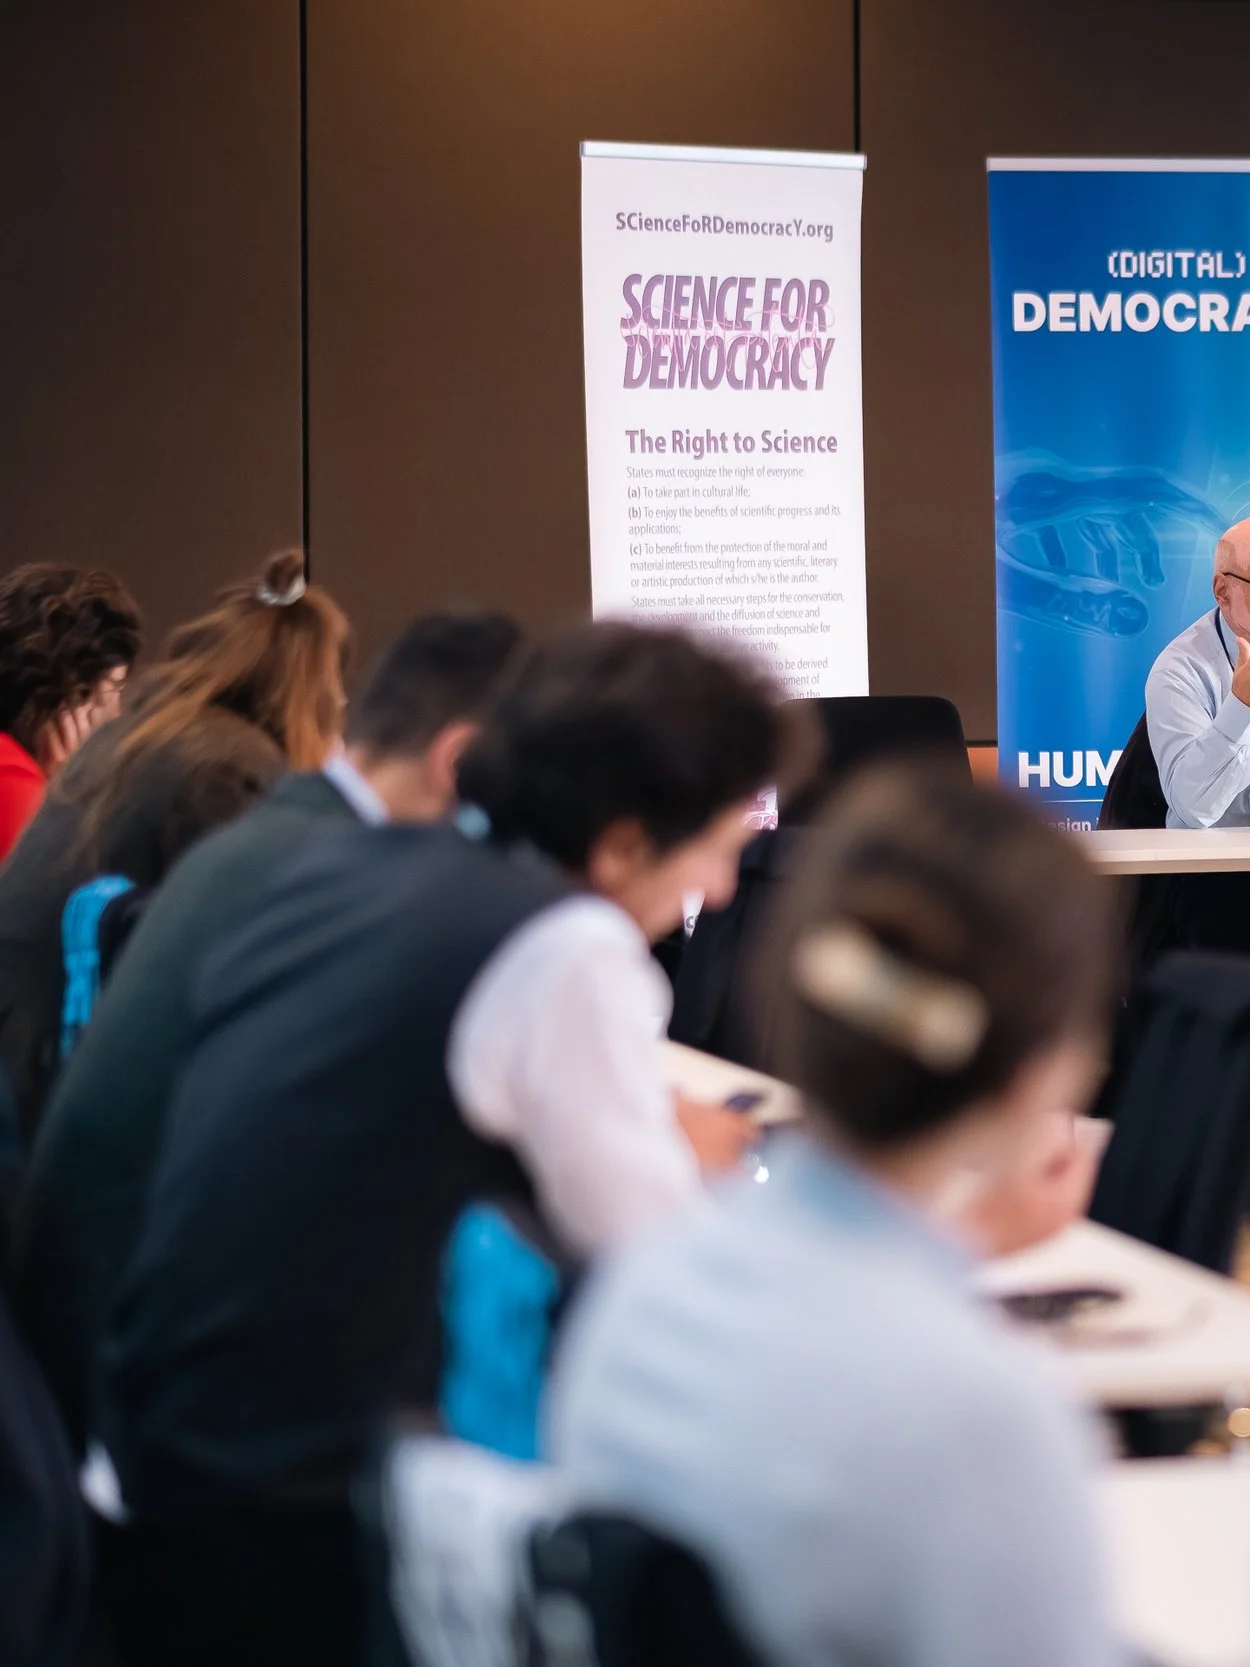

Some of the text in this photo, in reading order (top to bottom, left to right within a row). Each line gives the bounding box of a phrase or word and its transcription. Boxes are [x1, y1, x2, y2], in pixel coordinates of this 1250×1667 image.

[615, 211, 834, 243] SCienceFoRDemocracY.org
[1107, 250, 1247, 279] (DIGITAL)
[620, 273, 831, 333] SCIENCE FOR
[622, 333, 836, 391] DEMOCRACY
[625, 428, 838, 460] The Right to Science
[626, 466, 654, 479] States
[655, 467, 676, 479] must
[677, 466, 717, 481] recognize
[718, 466, 733, 478] the
[734, 465, 755, 480] right
[756, 465, 767, 478] of
[627, 486, 641, 499] (a)
[643, 486, 653, 498] To
[655, 486, 672, 498] take
[674, 488, 690, 500] part
[692, 487, 701, 498] in
[702, 485, 734, 498] cultural
[628, 504, 842, 521] (b) To enjoy the benefits of scientific progress and its
[629, 539, 828, 556] (c) To benefit from the protection of the moral and
[630, 559, 664, 571] material
[665, 559, 698, 571] interests
[699, 557, 735, 572] resulting
[736, 557, 756, 568] from
[757, 559, 772, 570] any
[810, 555, 838, 569] literary
[630, 578, 640, 588] or
[641, 576, 669, 588] artistic
[669, 574, 714, 589] production
[714, 573, 724, 585] of
[724, 573, 749, 585] which
[769, 572, 776, 583] is
[777, 571, 790, 583] the
[631, 596, 656, 608] States
[657, 596, 678, 607] must
[678, 594, 694, 607] take
[695, 594, 705, 606] all
[706, 595, 745, 608] necessary
[746, 593, 767, 606] steps
[767, 591, 778, 604] for
[779, 591, 793, 603] the
[700, 608, 716, 621] and
[716, 608, 731, 621] the
[731, 607, 766, 620] diffusion
[766, 608, 775, 620] of
[776, 608, 804, 619] science
[805, 606, 821, 618] and
[732, 624, 766, 637] freedom
[767, 622, 819, 637] indispensable
[820, 621, 832, 634] for
[775, 659, 784, 671] to
[785, 659, 796, 671] be
[797, 657, 828, 670] derived
[811, 673, 821, 685] of
